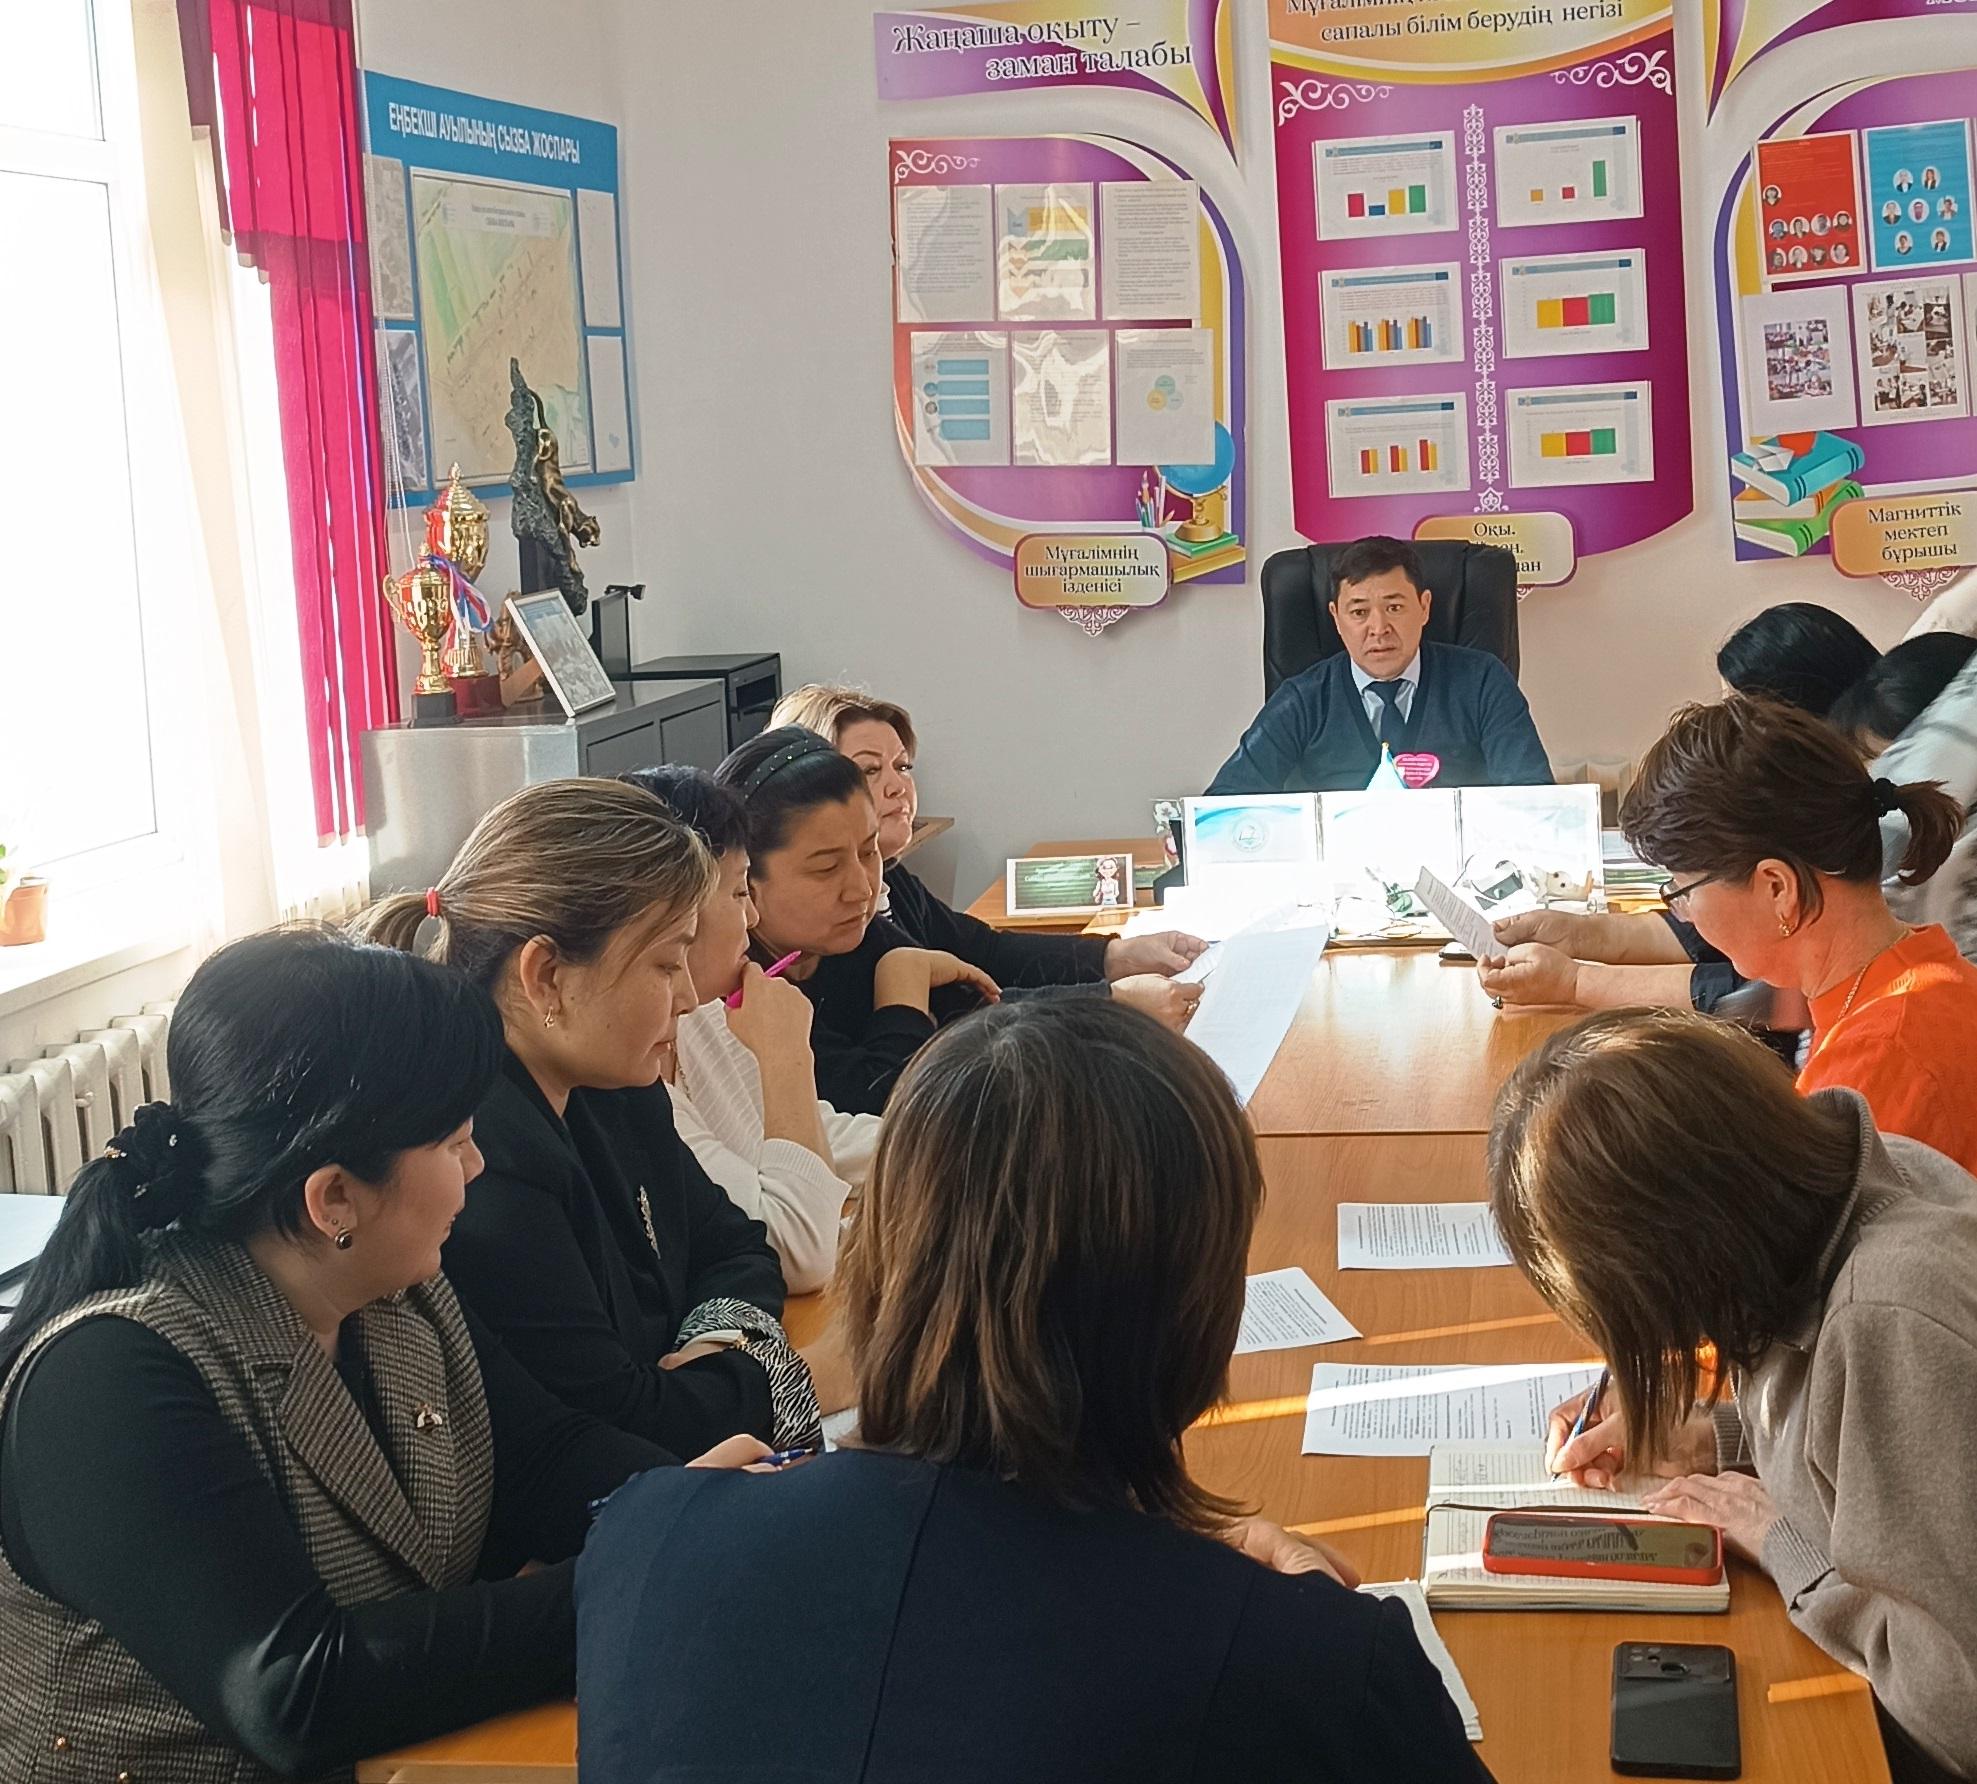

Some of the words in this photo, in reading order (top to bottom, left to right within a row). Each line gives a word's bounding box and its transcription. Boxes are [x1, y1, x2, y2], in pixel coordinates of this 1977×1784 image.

[894, 24, 1020, 52] Жаңаша
[1027, 17, 1120, 44] оқыту
[1321, 20, 1401, 42] сапалы
[1407, 11, 1462, 35] білім
[1467, 5, 1553, 31] берудің
[1562, 0, 1624, 21] негізі
[986, 52, 1077, 79] заман
[1082, 41, 1192, 70] талабы
[388, 101, 437, 138] ЕҢБЕКШІ
[439, 113, 499, 154] АУЫЛЫНЫҢ
[498, 124, 532, 155] СЫЗБА
[532, 131, 581, 164] ЖОСПАРЫ
[1868, 501, 1962, 523] Магниттік
[1473, 522, 1516, 537] Оқы.
[1884, 524, 1949, 542] мектеп
[1062, 578, 1122, 594] ізденісі
